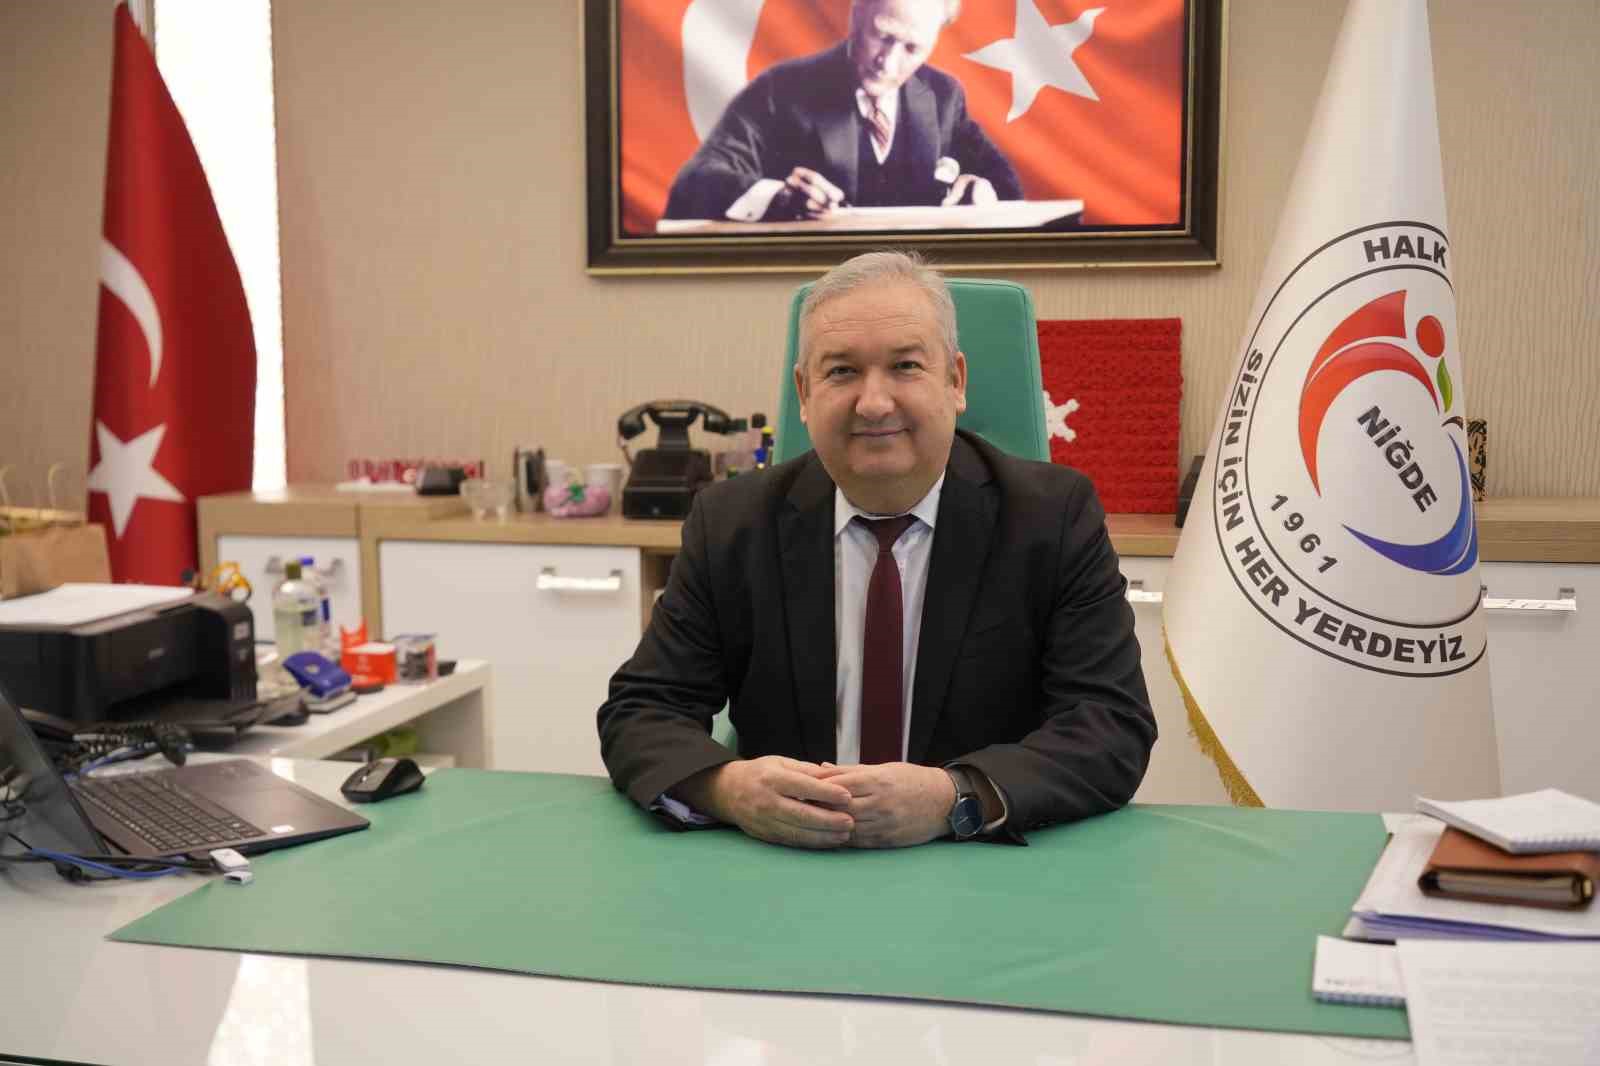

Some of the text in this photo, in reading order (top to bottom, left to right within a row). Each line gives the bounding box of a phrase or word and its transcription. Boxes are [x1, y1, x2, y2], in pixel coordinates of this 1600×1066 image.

[1363, 235, 1447, 269] HALK
[1357, 405, 1438, 513] NİĞDE
[1217, 349, 1467, 664] SİZİN İÇİN HER YERDEYİZ
[1270, 494, 1338, 574] 1961
